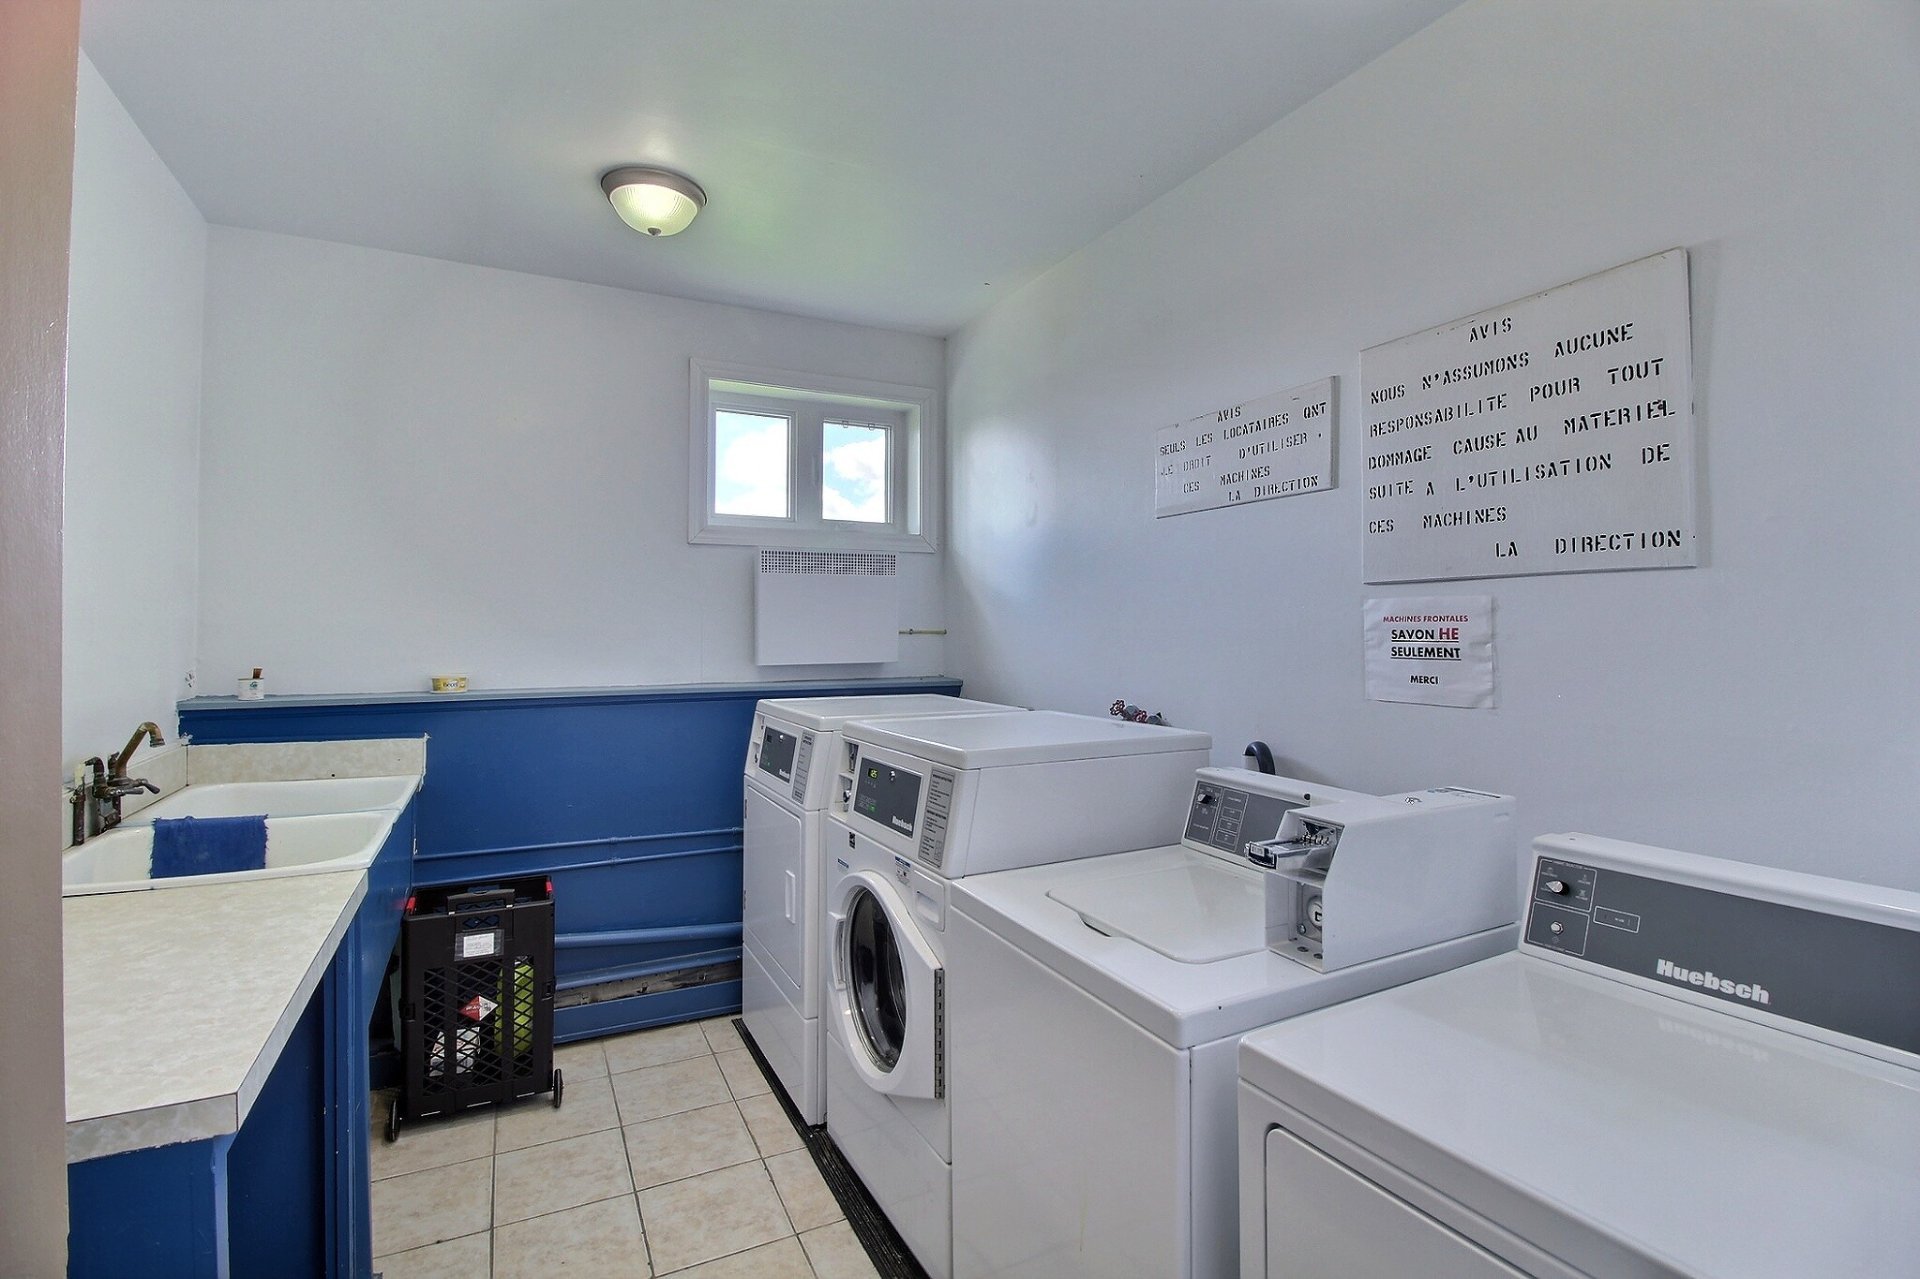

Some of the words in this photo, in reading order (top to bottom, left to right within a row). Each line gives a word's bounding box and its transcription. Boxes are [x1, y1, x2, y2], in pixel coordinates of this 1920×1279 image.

[1468, 316, 1512, 342] AVIS
[1370, 384, 1405, 404] NOUS
[1422, 352, 1530, 390] N'ASSUMONS
[1554, 323, 1634, 358] AUCUNE
[1369, 393, 1508, 437] RESPONSABILITE
[1530, 377, 1580, 402] POUR
[1608, 357, 1664, 385] TOUT
[1217, 406, 1241, 423] AVIS
[1160, 440, 1186, 456] SEULS
[1196, 433, 1213, 447] LES
[1223, 412, 1289, 440] LOCATAIRES
[1368, 446, 1432, 470] DOMMAGE
[1453, 431, 1507, 455] CAUSE
[1515, 425, 1538, 445] AU
[1564, 399, 1676, 435] MATERIEL
[1183, 455, 1211, 472] DROIT
[1239, 432, 1307, 459] D'UTILISER
[1183, 481, 1200, 493] CES
[1220, 466, 1270, 486] MACHINES
[1369, 480, 1414, 500] SUITE
[1425, 482, 1434, 496] A
[1456, 453, 1612, 492] L'UTILISATION
[1642, 443, 1671, 464] DE
[1228, 490, 1241, 501] LA
[1254, 475, 1318, 498] DIRECTION
[1369, 519, 1394, 534] CES
[1423, 506, 1508, 530] MACHINES
[1495, 541, 1518, 558] LA
[1555, 529, 1682, 555] DIRECTION
[1383, 615, 1421, 623] MACHINES
[1423, 615, 1469, 623] FRONTALES
[1391, 629, 1435, 640] SAVON
[1439, 628, 1459, 640] HE
[1391, 647, 1461, 658] SEULEMENT
[1410, 675, 1439, 685] MERCI
[1656, 958, 1770, 1004] Huebsch
